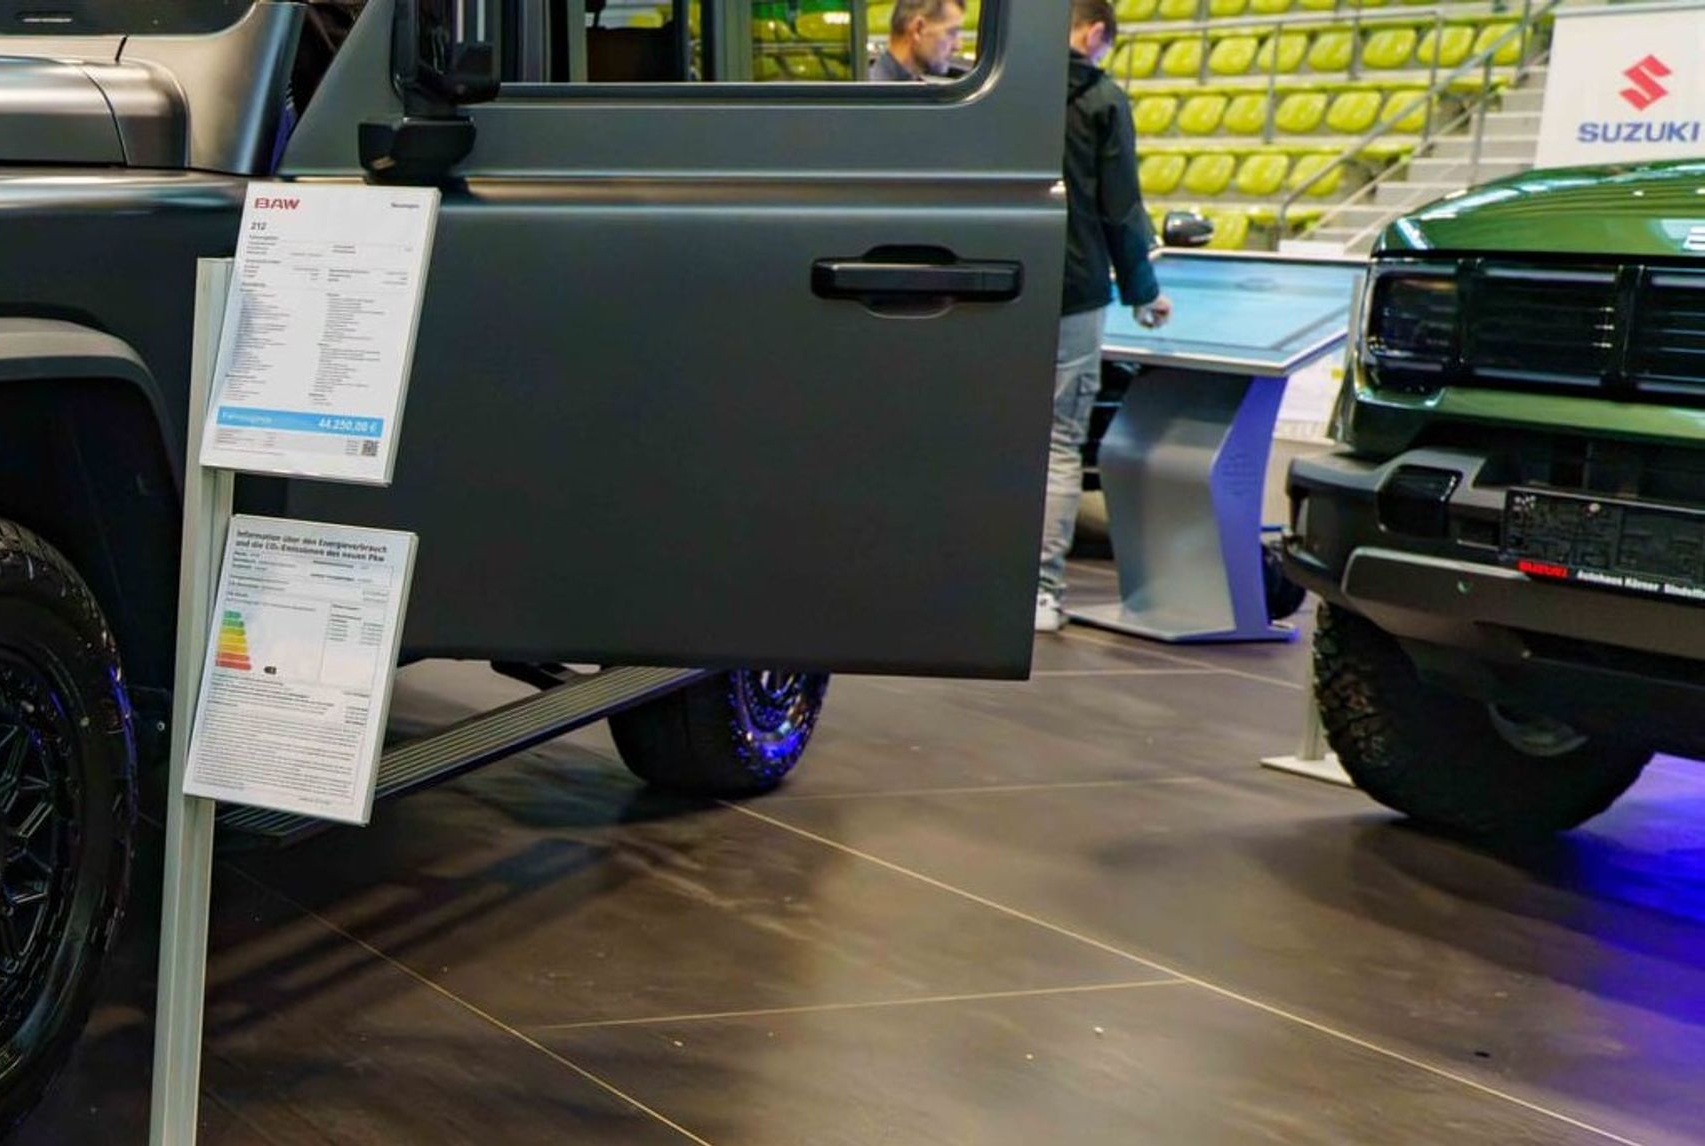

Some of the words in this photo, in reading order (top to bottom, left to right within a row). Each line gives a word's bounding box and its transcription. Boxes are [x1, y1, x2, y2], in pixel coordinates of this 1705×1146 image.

[1577, 121, 1701, 143] SUZUKI
[254, 197, 300, 210] BAW
[250, 221, 267, 231] 212
[236, 530, 281, 542] Information
